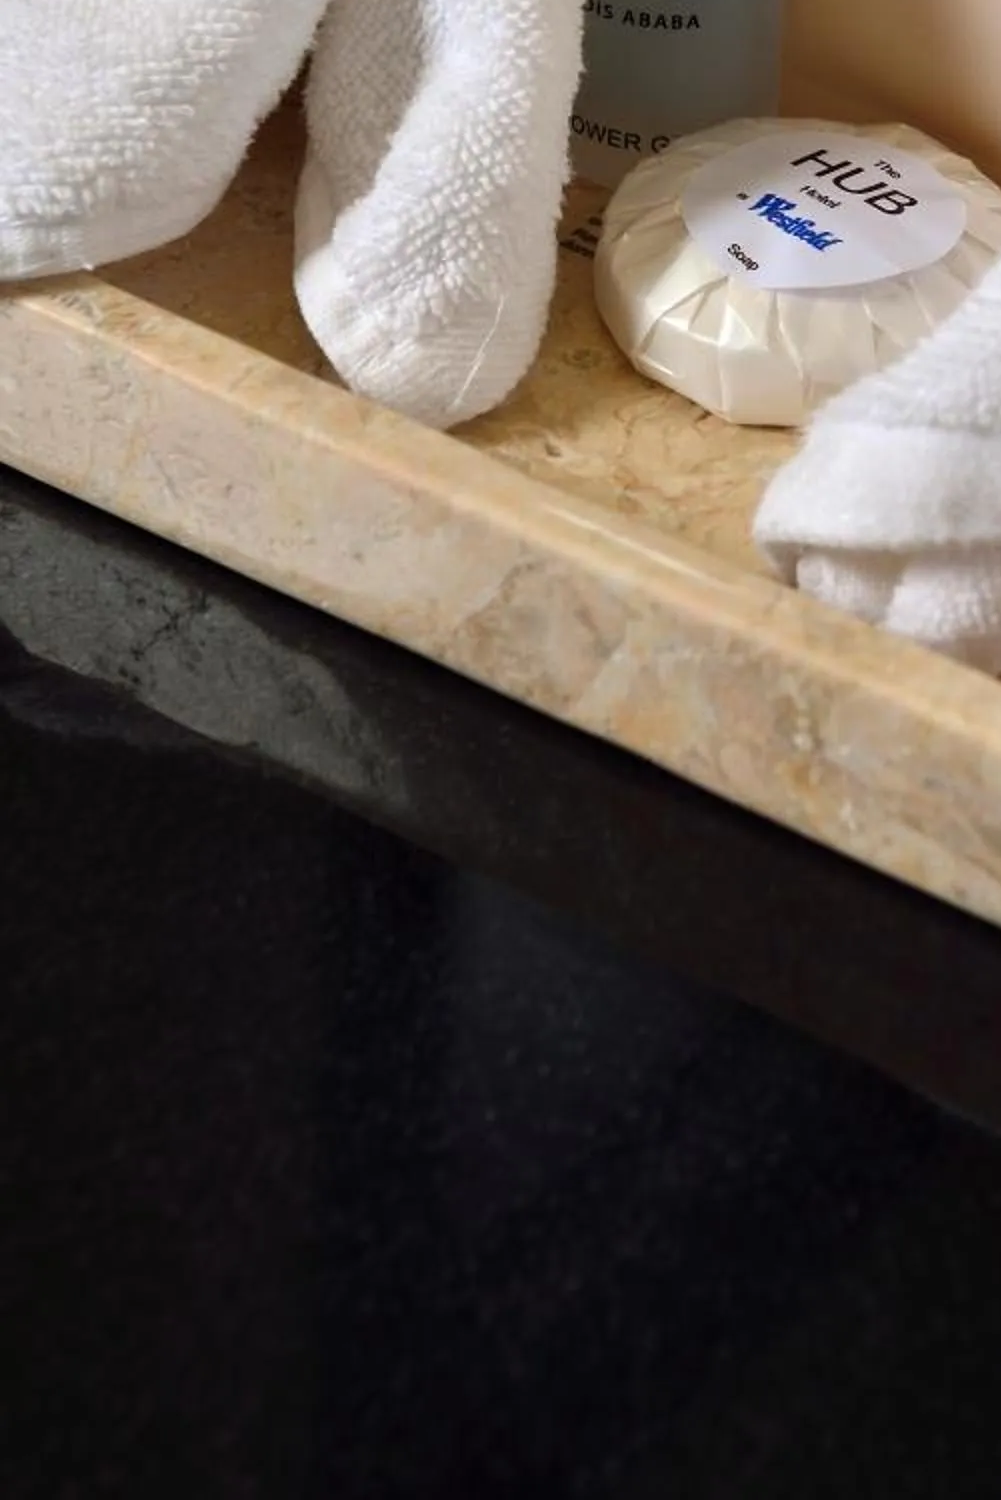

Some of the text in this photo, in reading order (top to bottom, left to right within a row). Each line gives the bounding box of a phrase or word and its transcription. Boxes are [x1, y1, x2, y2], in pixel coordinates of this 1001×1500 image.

[621, 9, 702, 31] ABABA
[571, 114, 642, 151] OWER
[789, 148, 919, 216] HUB
[873, 159, 902, 180] The
[748, 192, 845, 253] Westfield
[726, 242, 760, 272] Soap
